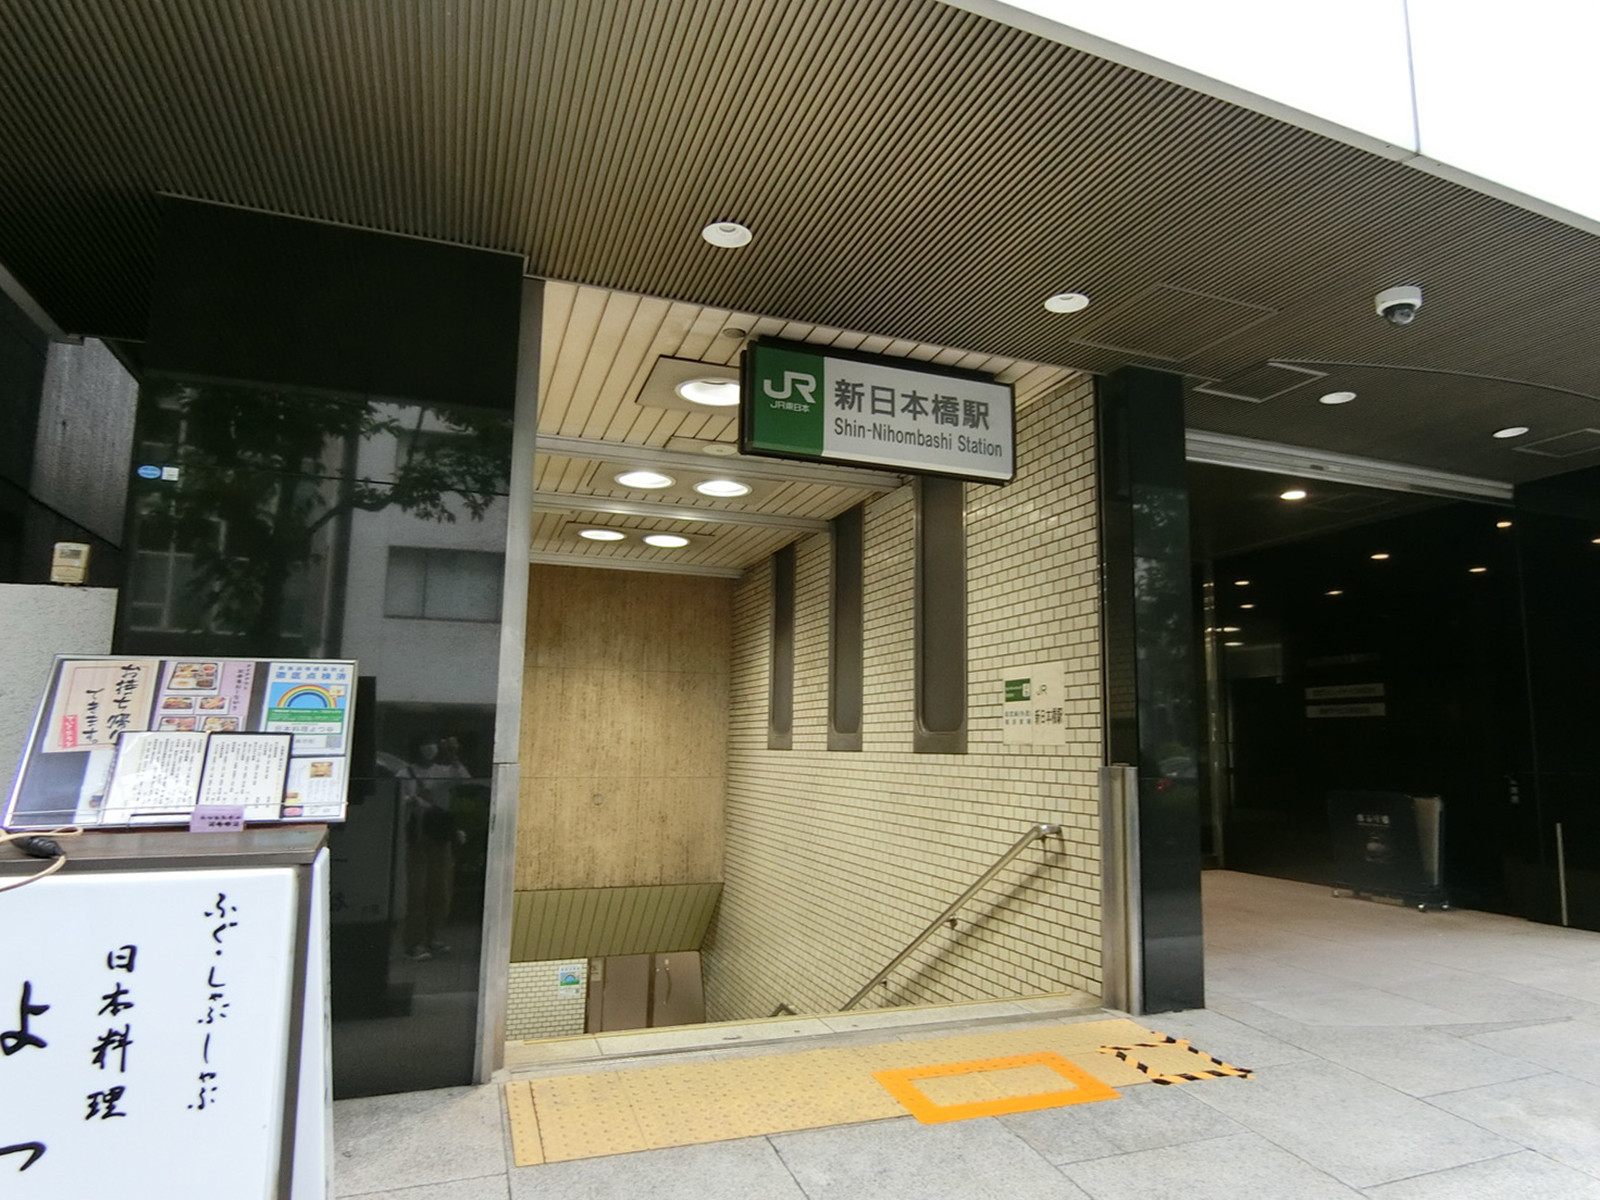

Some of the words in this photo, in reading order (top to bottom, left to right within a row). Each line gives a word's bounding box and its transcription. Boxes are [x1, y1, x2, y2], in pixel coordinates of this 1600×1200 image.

[763, 370, 817, 404] JR
[770, 400, 810, 413] JR東日本
[834, 378, 990, 431] 新日本橋駅
[834, 417, 953, 450] Shin-Nihombashi
[957, 434, 1003, 457] Station
[84, 944, 138, 1121] 日本料理
